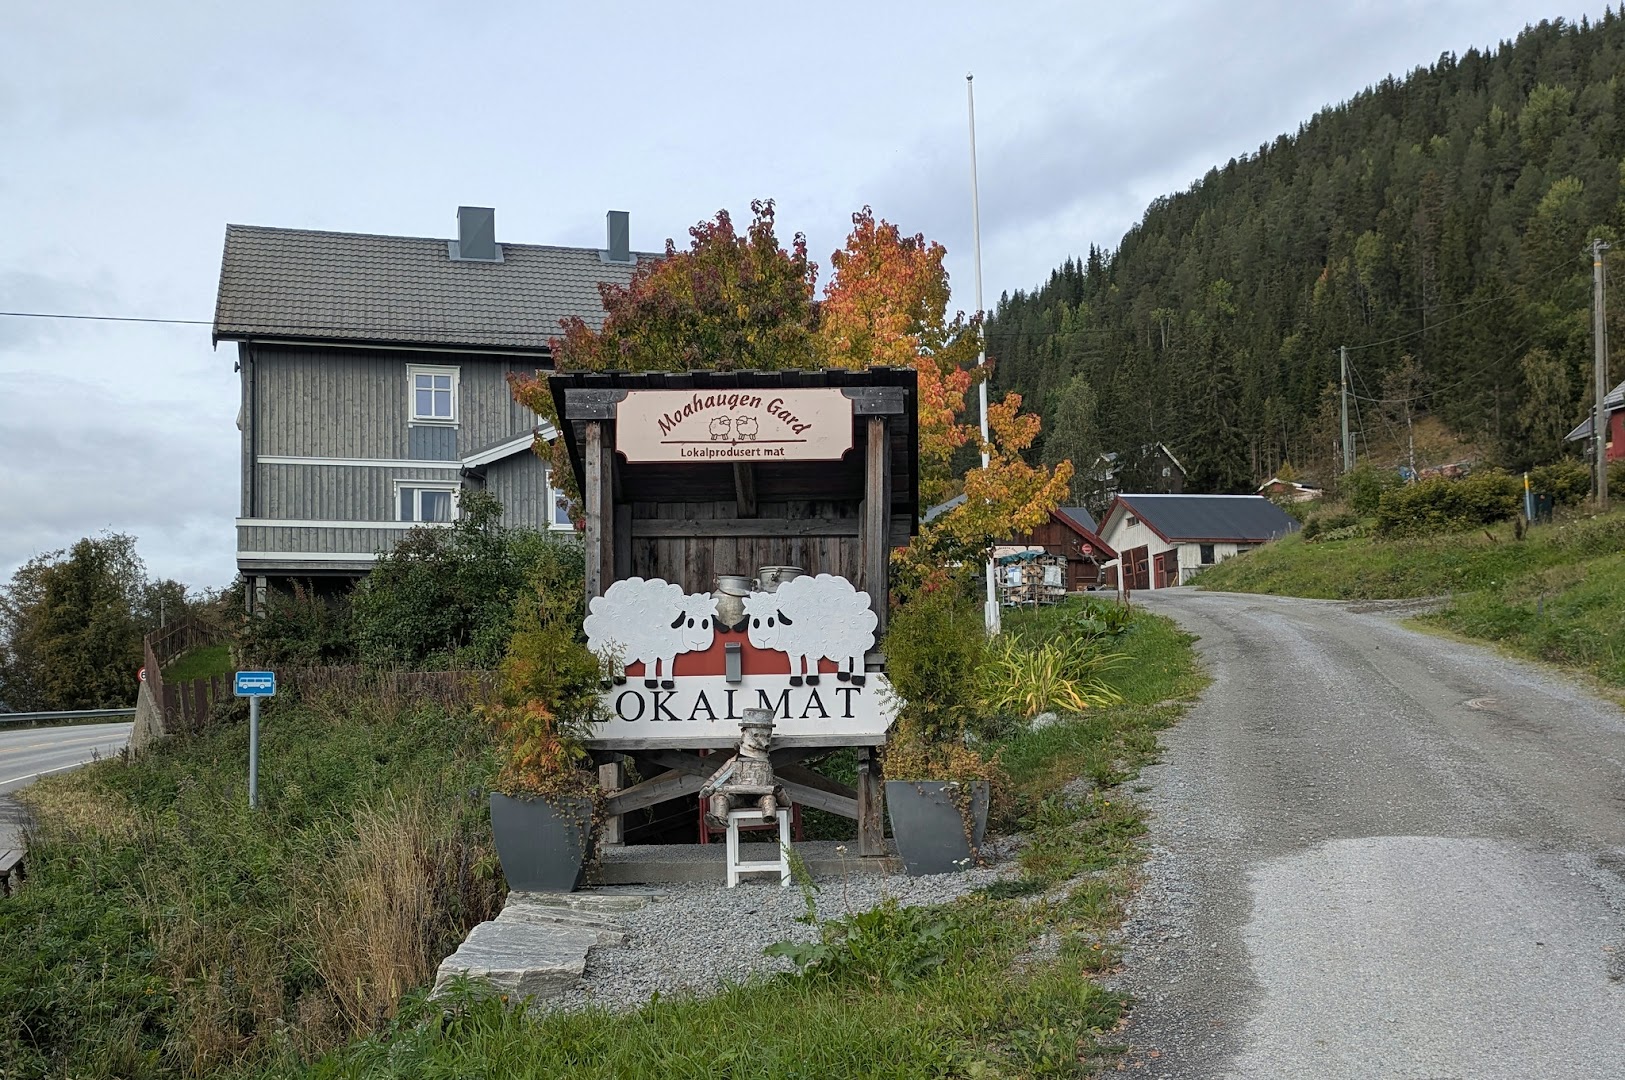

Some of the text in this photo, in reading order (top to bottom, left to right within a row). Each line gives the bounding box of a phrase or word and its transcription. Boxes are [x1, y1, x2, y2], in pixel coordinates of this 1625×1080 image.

[658, 393, 812, 436] Moahaugen Gard
[681, 447, 785, 459] Lokalprodusert mat
